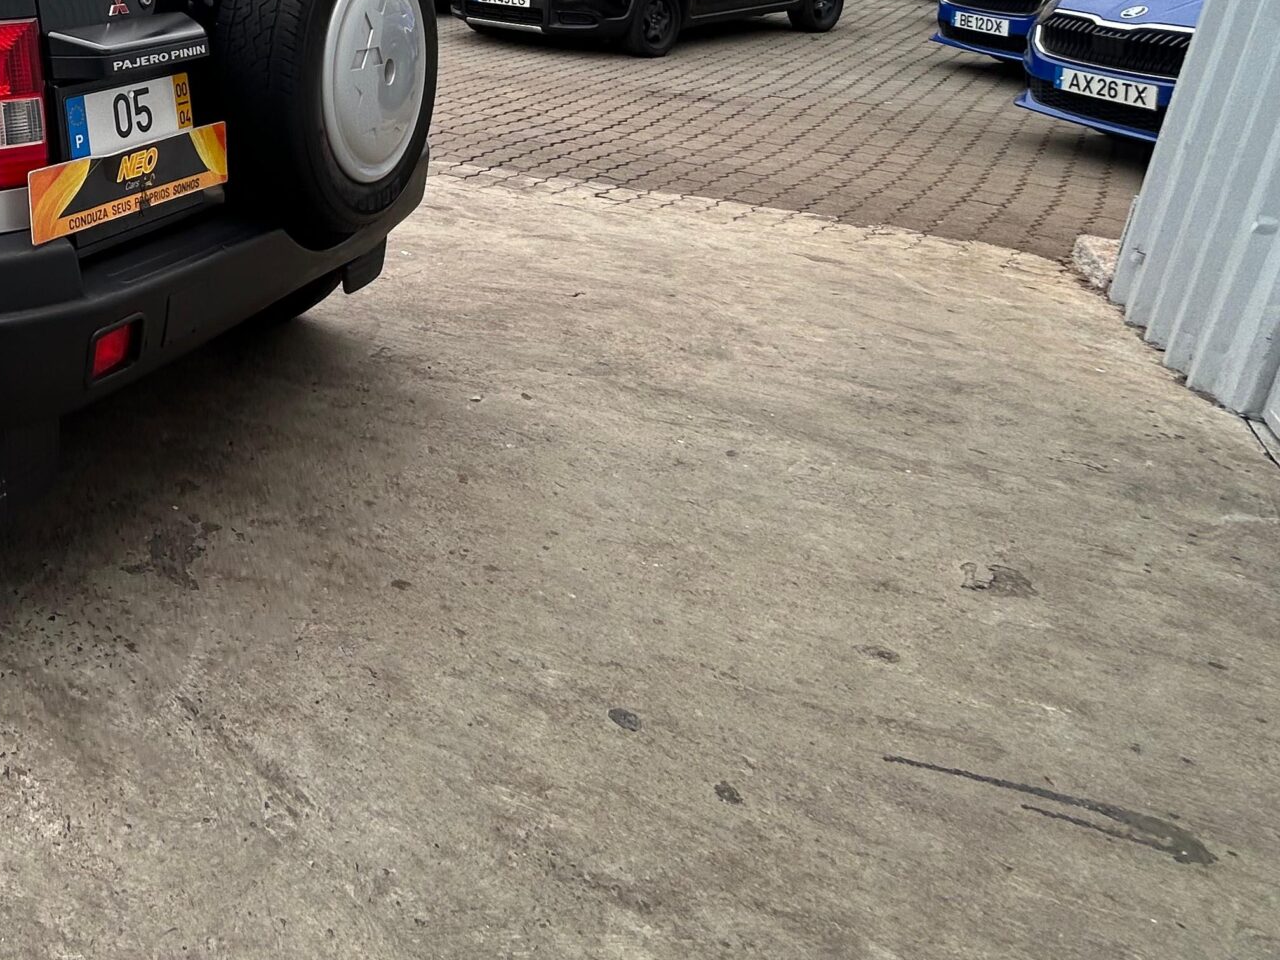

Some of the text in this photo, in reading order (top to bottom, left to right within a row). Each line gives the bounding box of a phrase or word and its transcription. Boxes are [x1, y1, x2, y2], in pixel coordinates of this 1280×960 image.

[113, 44, 206, 71] PAJERO PININ
[175, 82, 188, 98] 00
[113, 87, 153, 138] 05
[179, 110, 192, 125] 04
[75, 134, 84, 149] P
[117, 147, 159, 183] NEO
[68, 207, 109, 230] CONDUZA
[111, 200, 132, 216] SEUS
[172, 178, 200, 196] SONHOS
